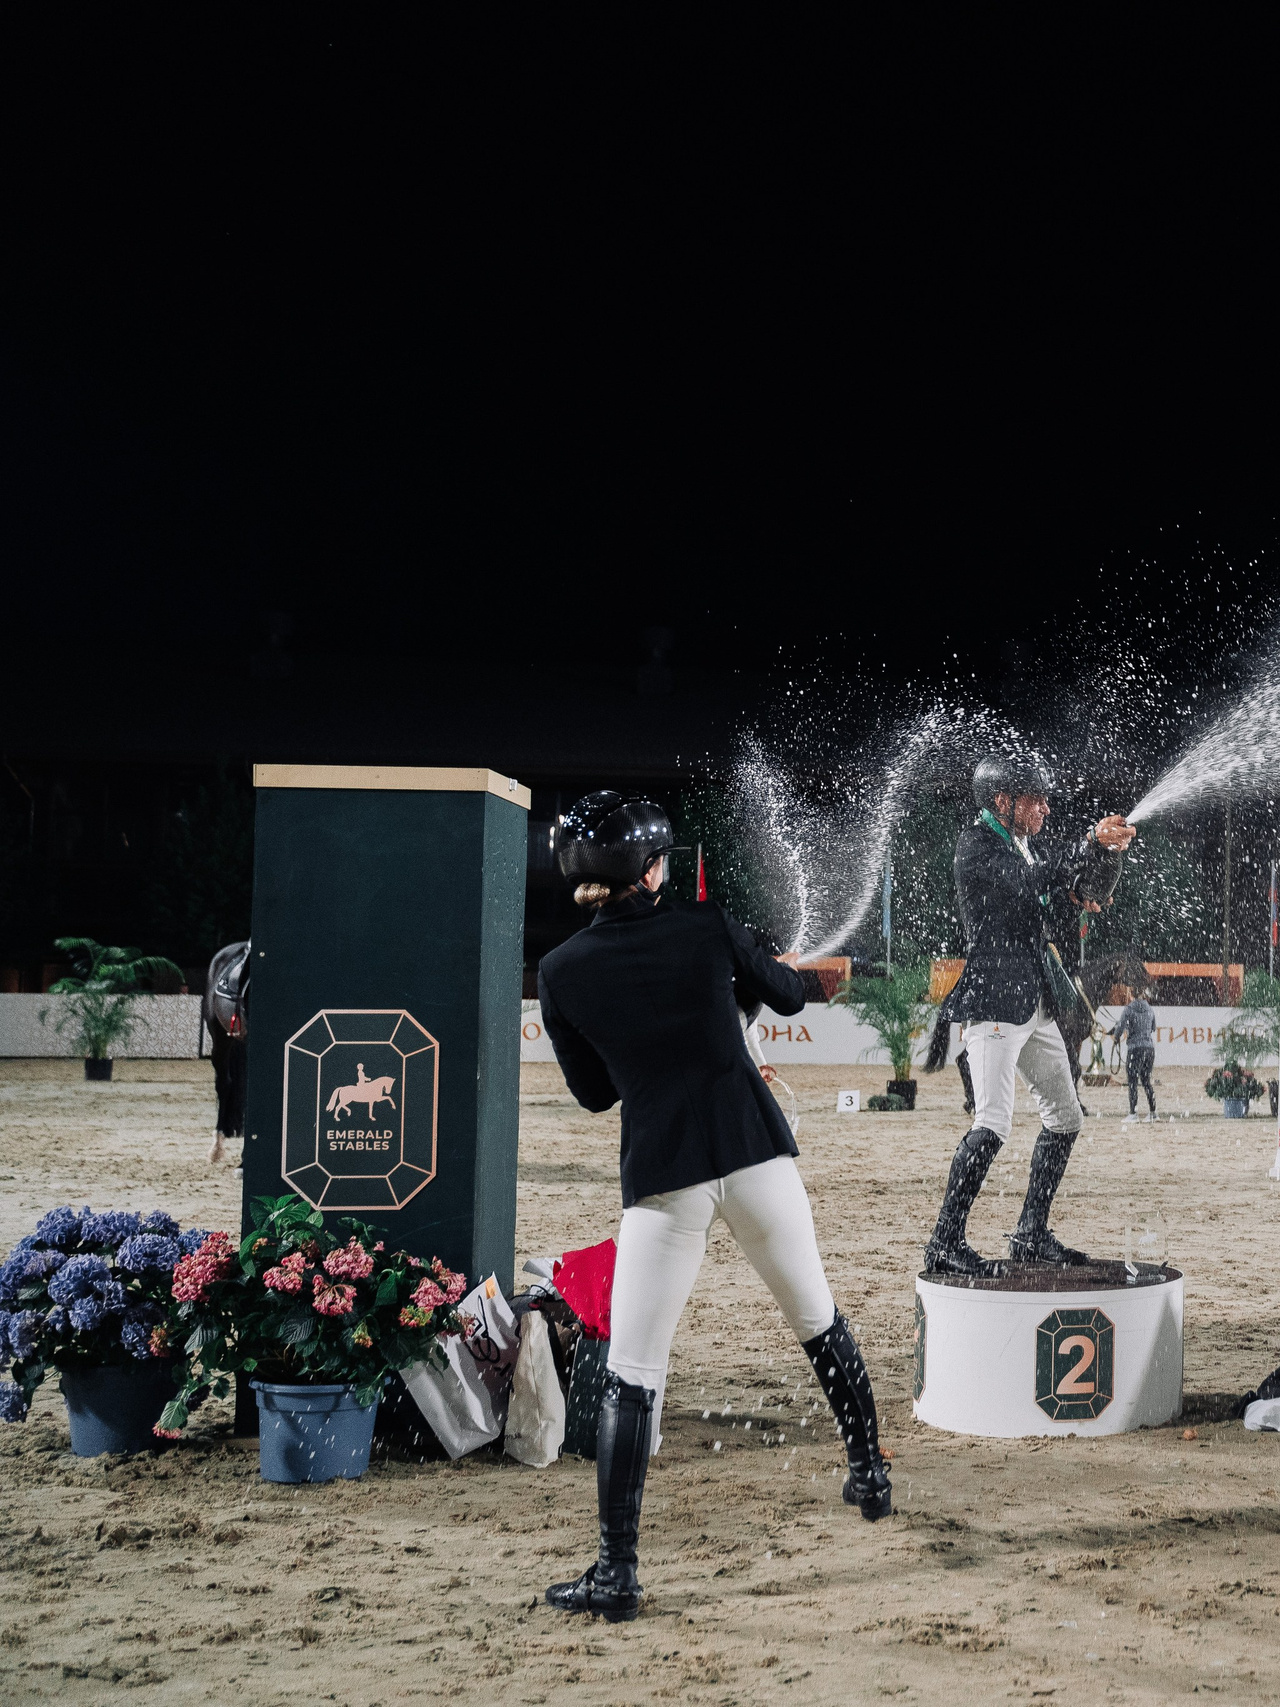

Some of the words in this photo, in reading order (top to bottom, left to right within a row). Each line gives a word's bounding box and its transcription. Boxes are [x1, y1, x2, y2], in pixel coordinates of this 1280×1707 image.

[845, 1095, 854, 1106] 3
[326, 1129, 393, 1139] EMERALD
[329, 1141, 390, 1151] STABLES
[1056, 1334, 1096, 1395] 2
